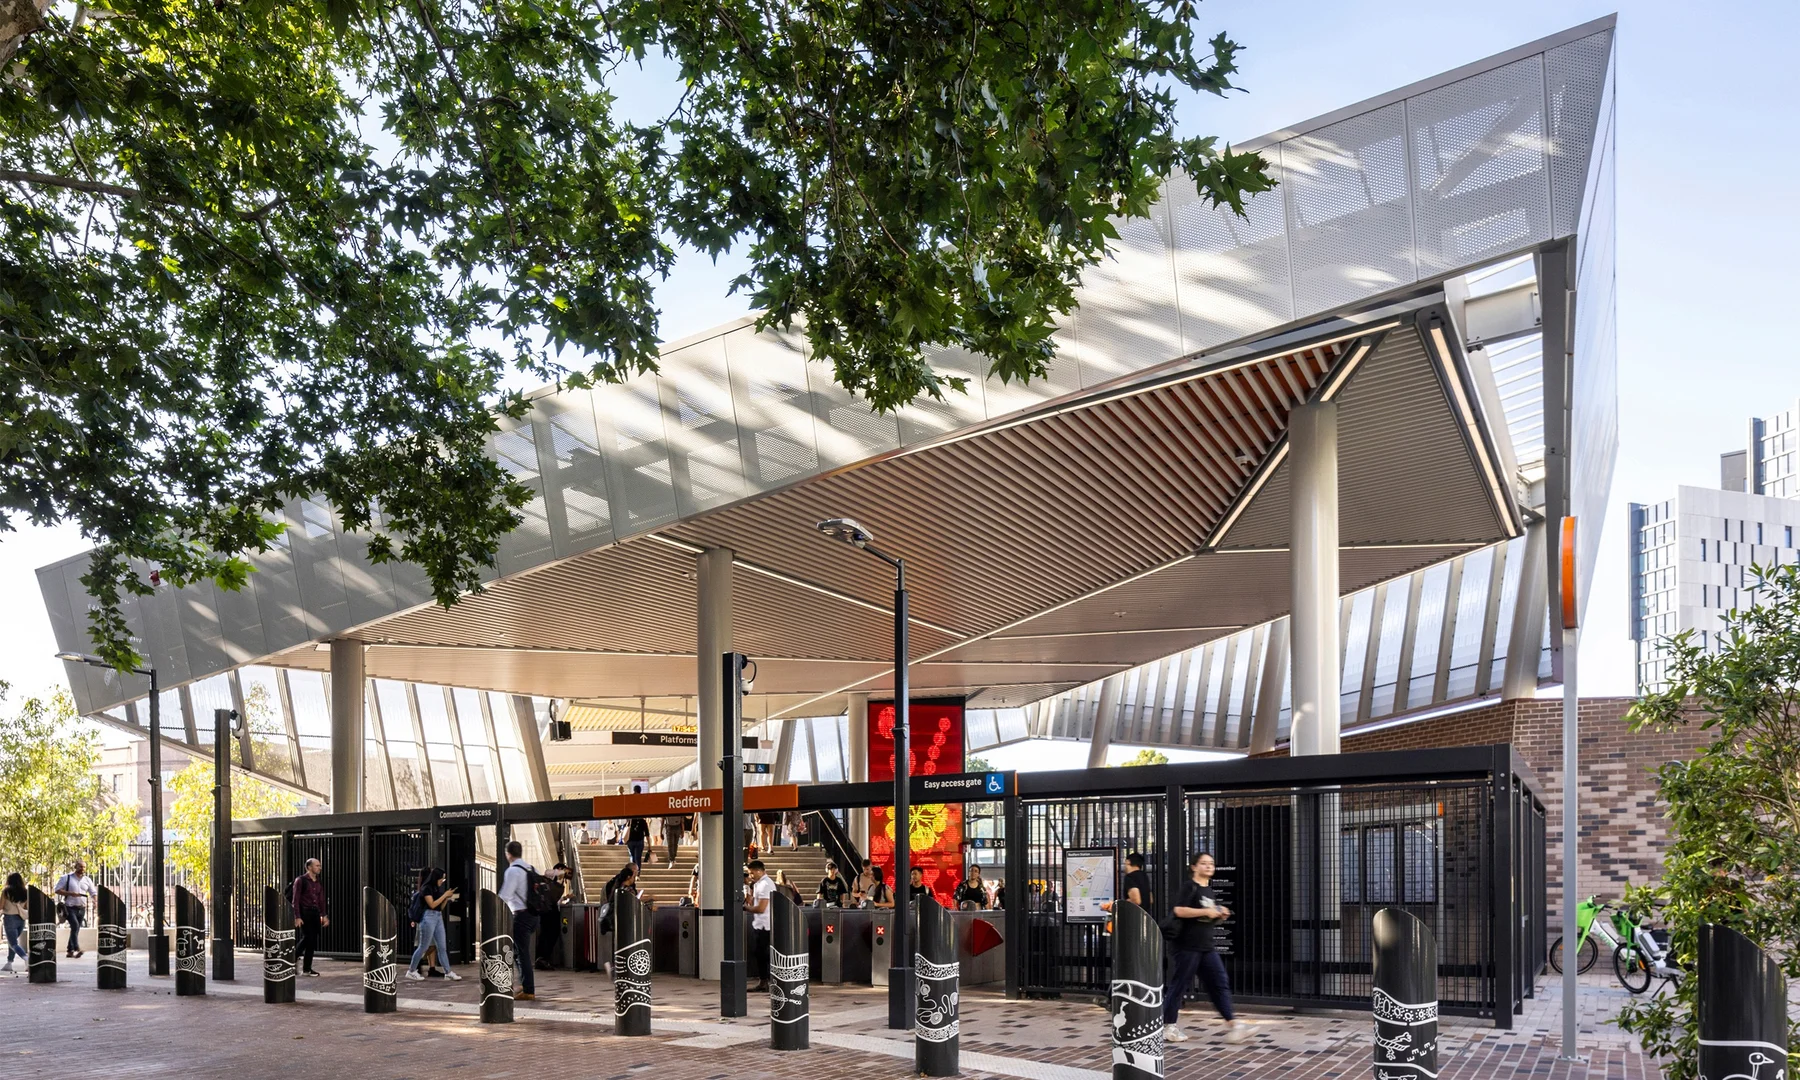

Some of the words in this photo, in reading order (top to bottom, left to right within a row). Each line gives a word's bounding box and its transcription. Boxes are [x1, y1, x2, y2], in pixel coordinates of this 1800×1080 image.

[660, 735, 698, 745] Platforms
[924, 781, 940, 790] Easy
[940, 780, 965, 788] access
[965, 778, 982, 788] gate
[668, 795, 711, 809] Redfern
[439, 810, 471, 819] Community
[471, 809, 492, 817] Access
